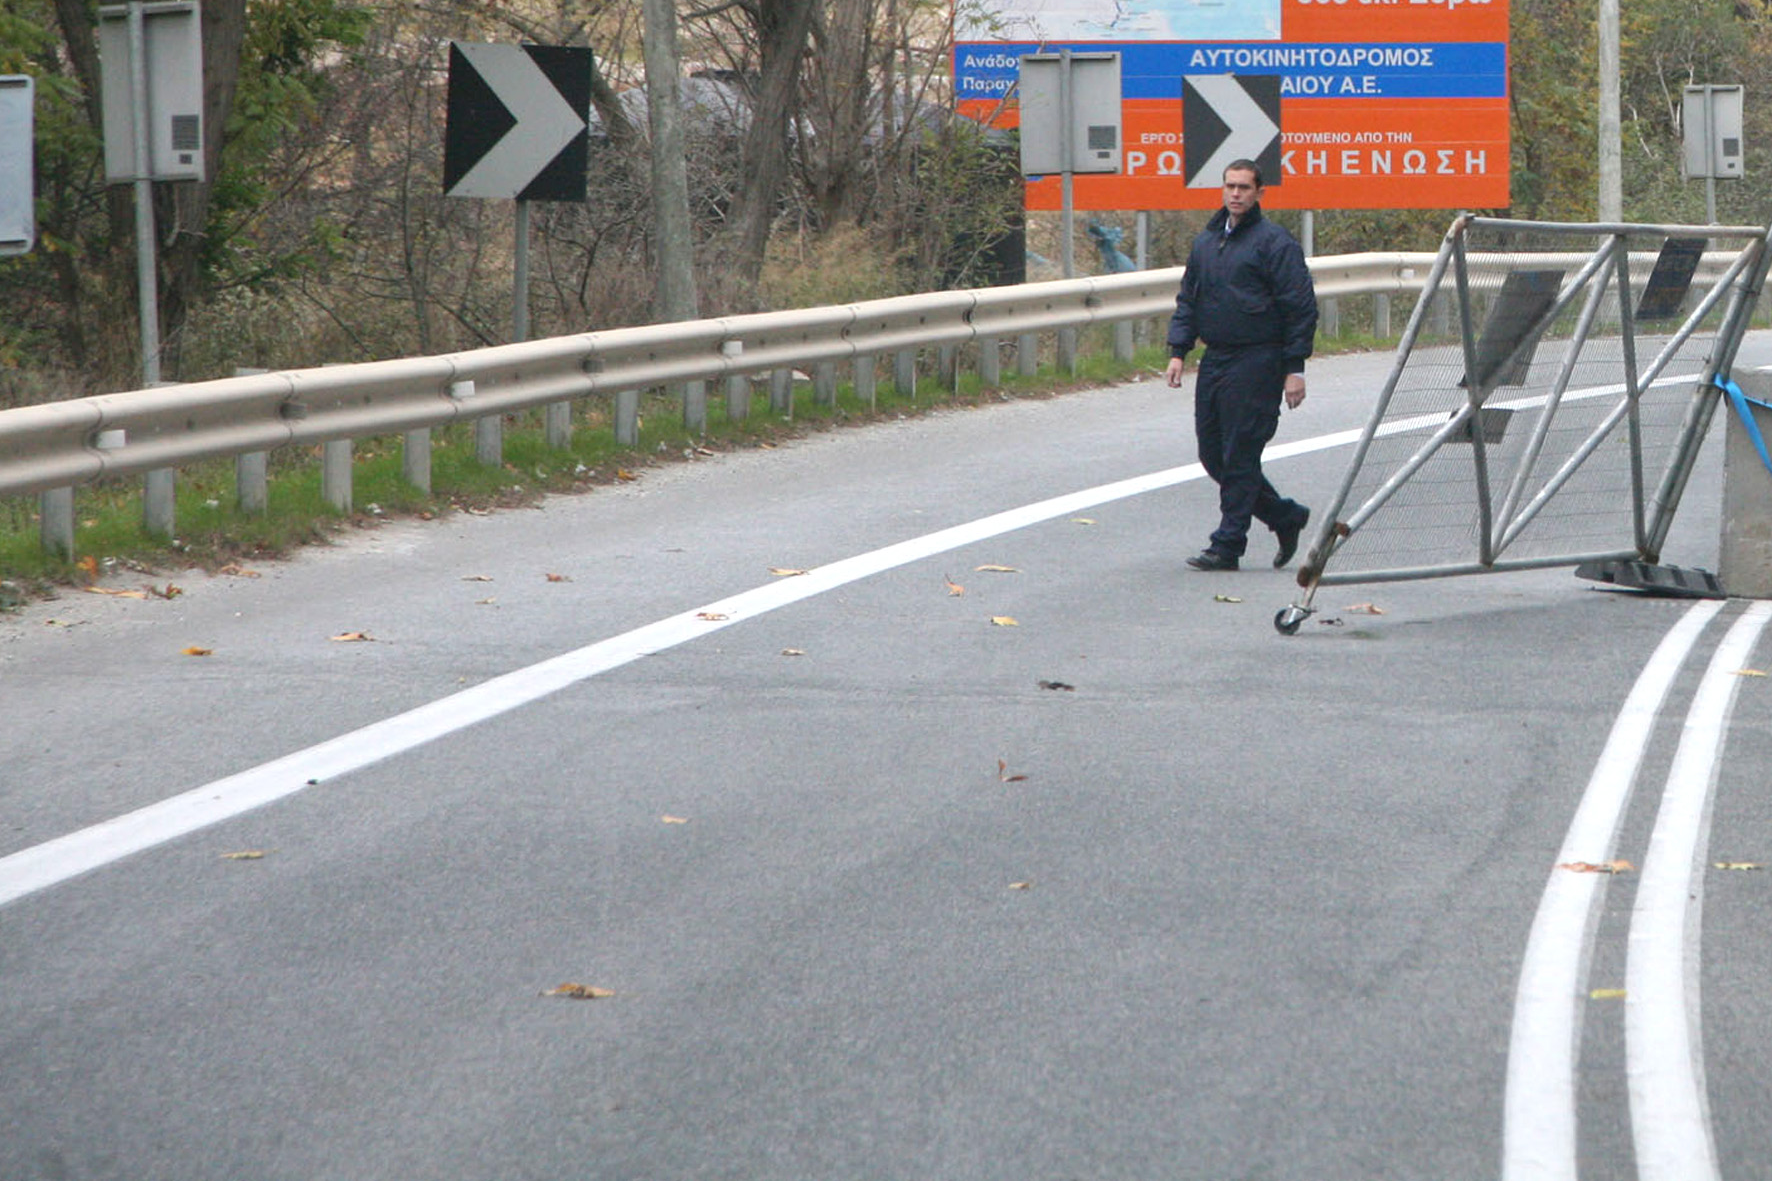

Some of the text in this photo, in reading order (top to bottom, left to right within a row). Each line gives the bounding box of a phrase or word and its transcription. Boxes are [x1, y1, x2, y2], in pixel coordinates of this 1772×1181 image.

[1190, 49, 1433, 67] ΑΥΤΟΚΙΝΗΤΟΔΡΟΜΟΣ
[1280, 76, 1382, 94] ΑΙΟΥ Α.Ε.
[1141, 132, 1177, 144] ΕΡΓΟ
[1354, 132, 1382, 143] ΑΠΟ
[1387, 132, 1412, 143] ΤΗΝ
